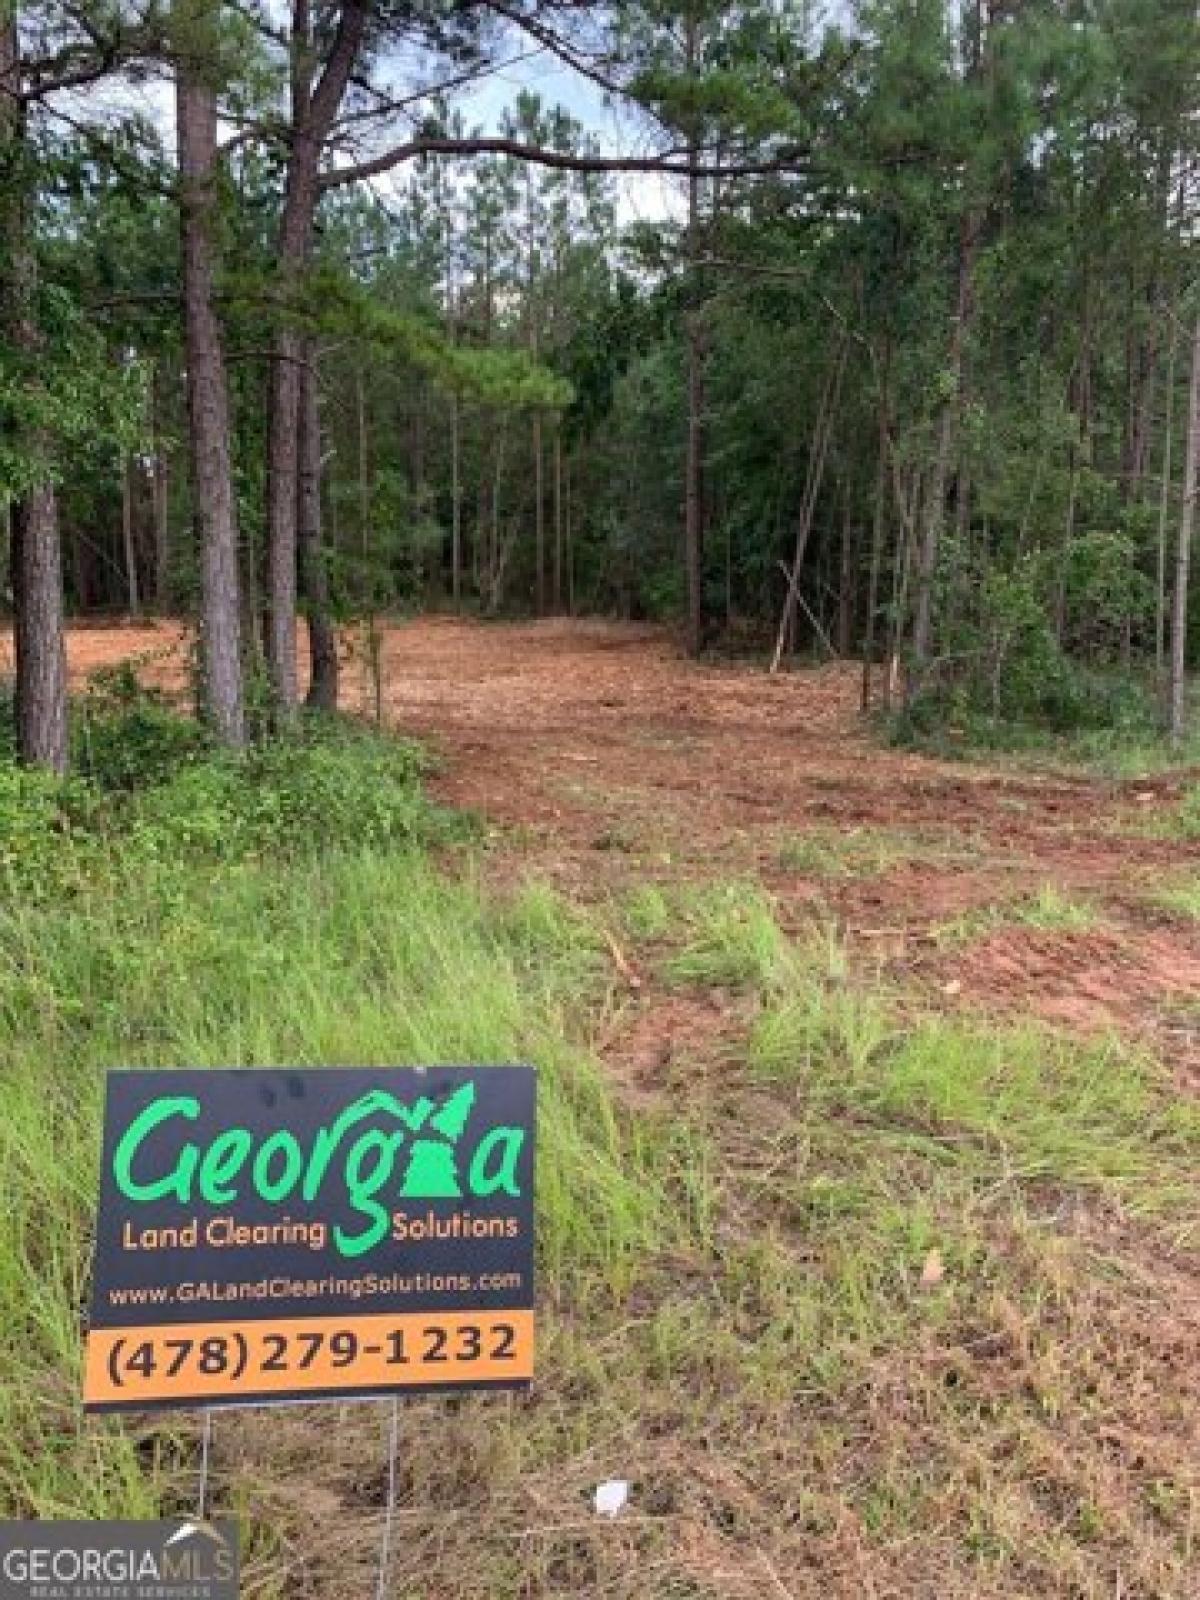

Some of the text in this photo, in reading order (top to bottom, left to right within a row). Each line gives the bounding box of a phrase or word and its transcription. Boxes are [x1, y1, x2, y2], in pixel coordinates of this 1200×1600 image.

[113, 1081, 525, 1257] Georgia
[122, 1210, 520, 1250] Land Clearing Solutions
[108, 1273, 521, 1305] www.GALandClearingSolutions.com
